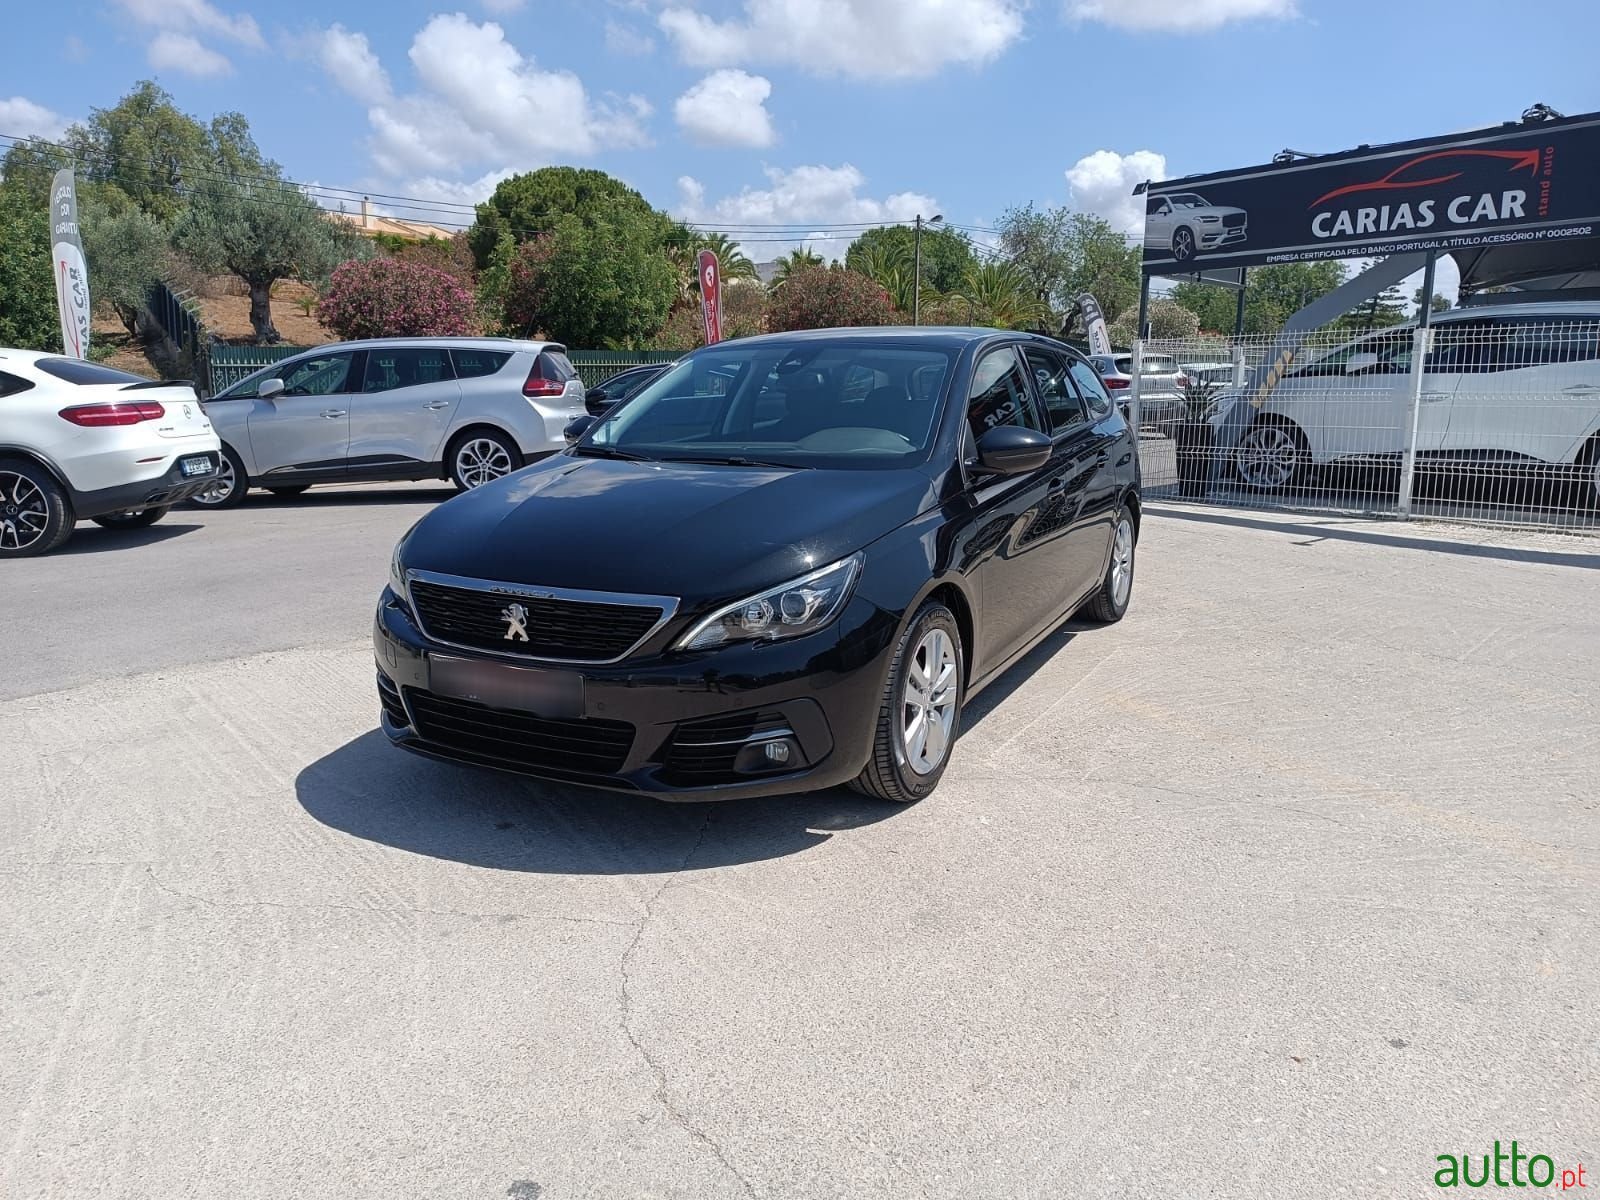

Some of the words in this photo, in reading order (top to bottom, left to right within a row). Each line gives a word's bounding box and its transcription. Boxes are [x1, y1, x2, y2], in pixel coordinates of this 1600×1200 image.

[1544, 146, 1554, 175] auto
[1311, 200, 1435, 238] CARIAS
[1447, 190, 1526, 223] CAR
[1539, 181, 1550, 216] stand
[1266, 253, 1299, 263] EMPRESA
[1300, 248, 1346, 260] CERTIFICADA
[1347, 246, 1367, 255] PELO
[1368, 243, 1395, 254] BANCO
[1397, 239, 1441, 251] PORTUGAL
[1442, 239, 1449, 247] A
[1450, 236, 1481, 246] TÍTULO
[1481, 231, 1534, 244] ACESSÓRIO
[1547, 226, 1592, 237] 0002502
[69, 267, 84, 309] CAR
